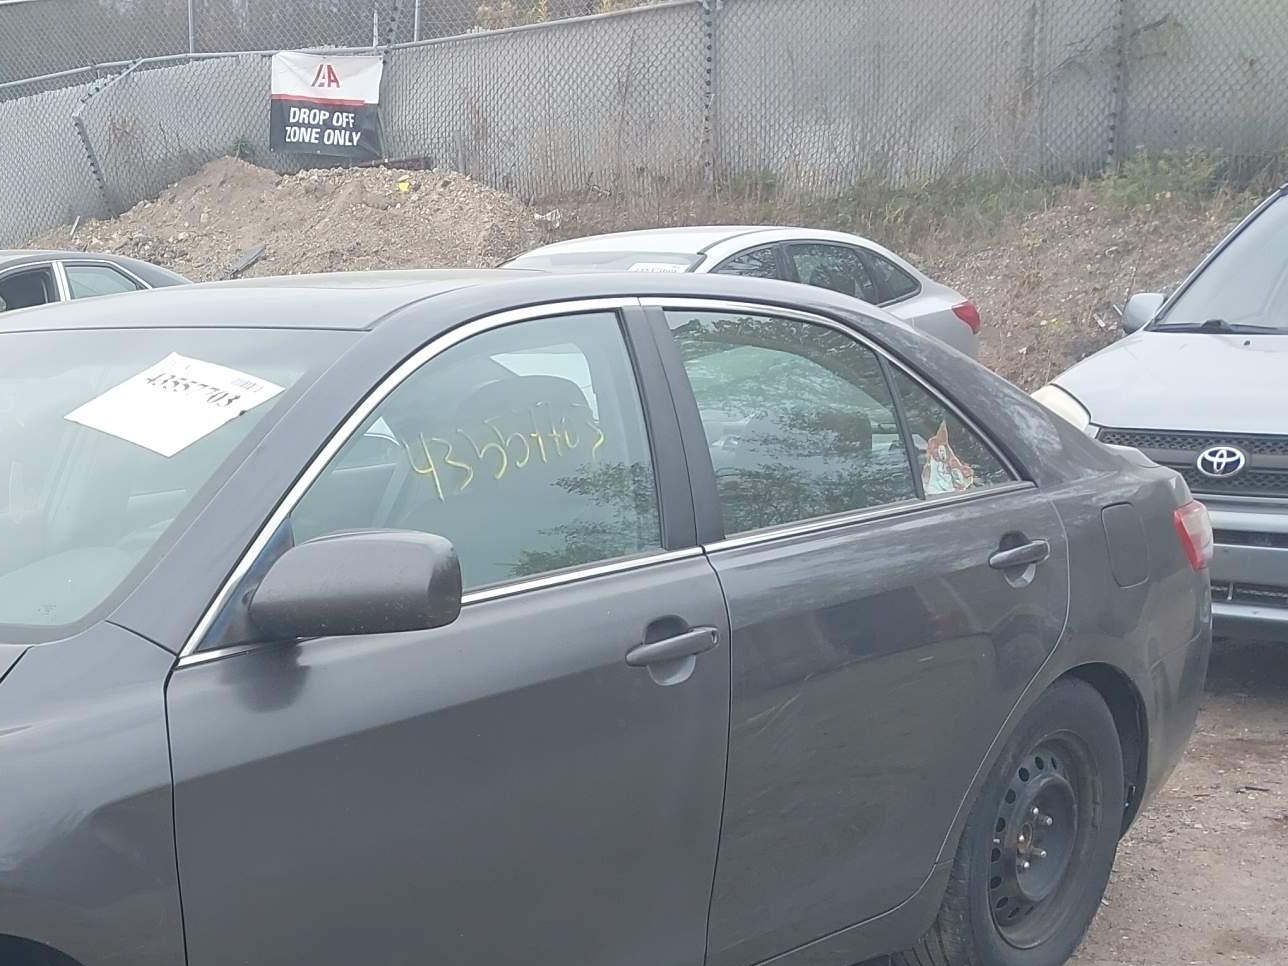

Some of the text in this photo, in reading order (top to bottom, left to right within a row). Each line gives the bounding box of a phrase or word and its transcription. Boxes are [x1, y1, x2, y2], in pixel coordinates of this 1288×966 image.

[289, 107, 355, 128] DROP OFF
[285, 126, 361, 146] ZONE ONLY
